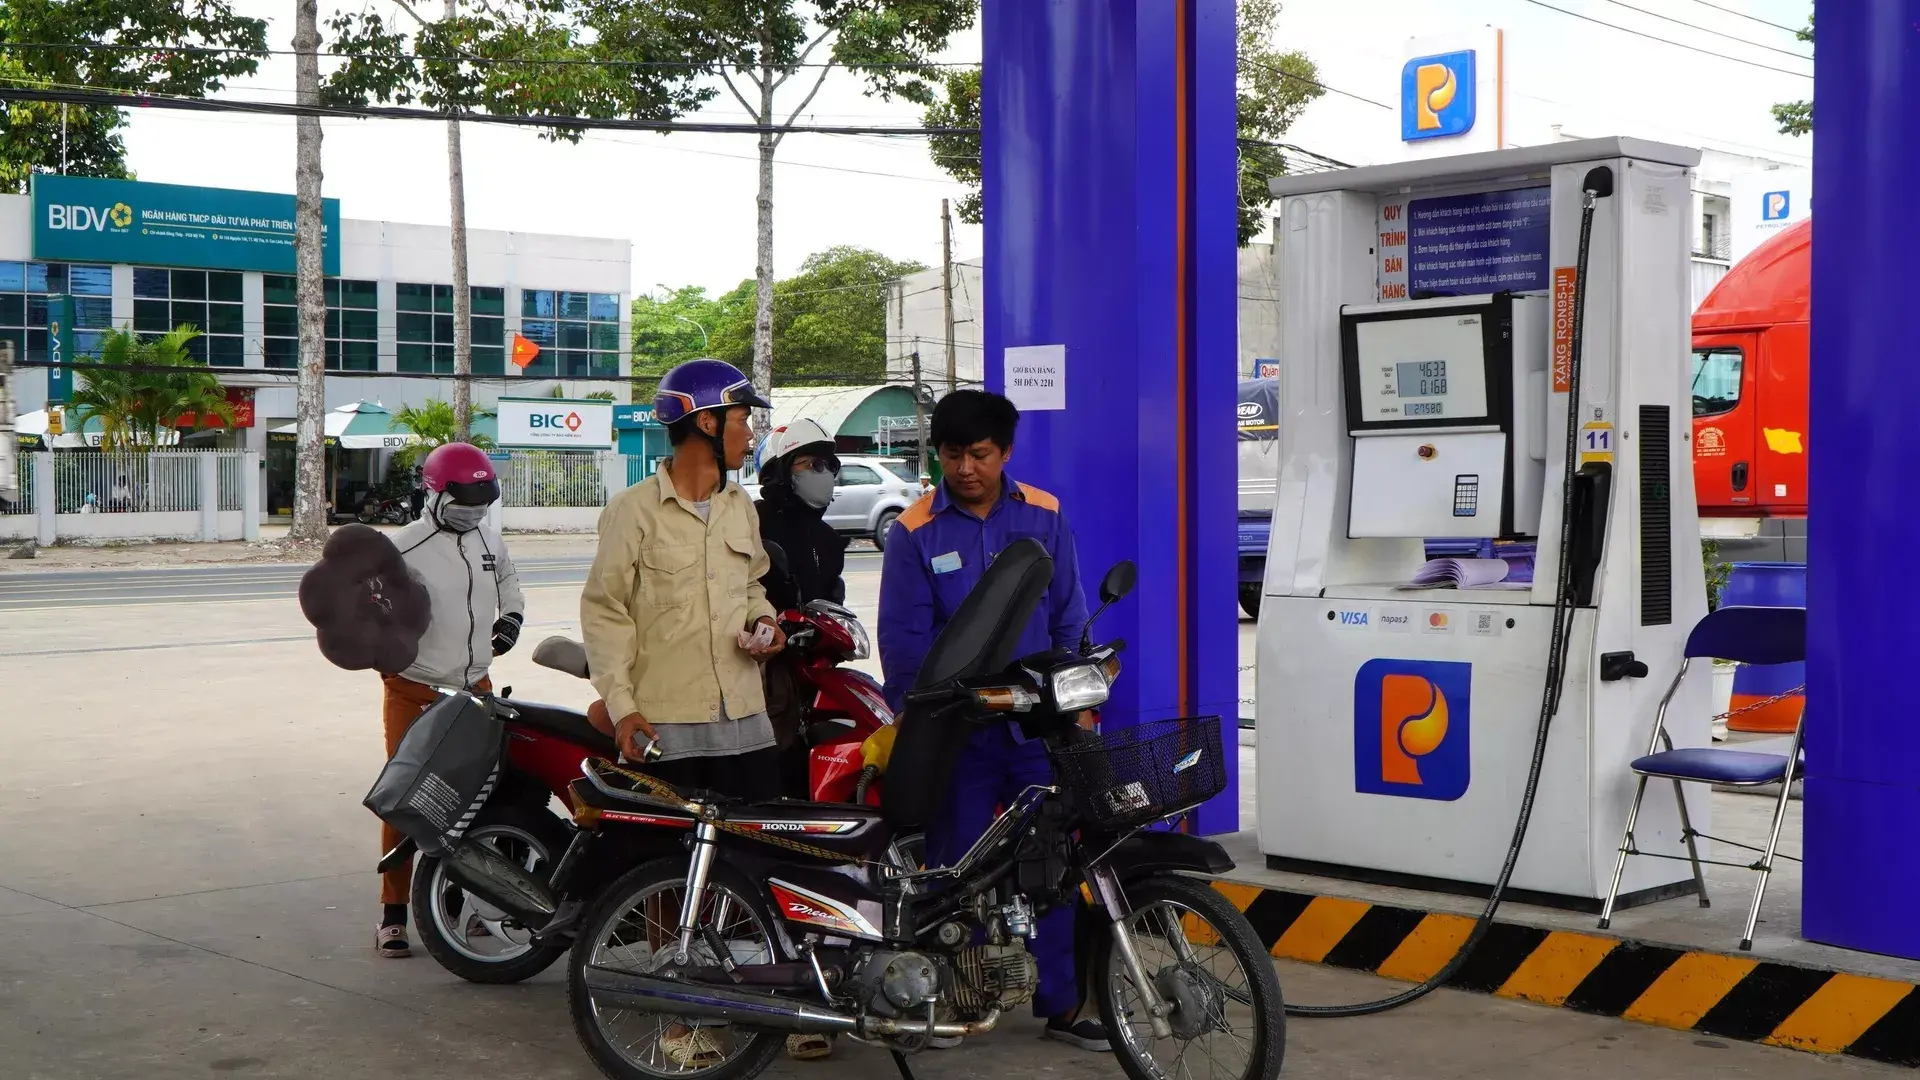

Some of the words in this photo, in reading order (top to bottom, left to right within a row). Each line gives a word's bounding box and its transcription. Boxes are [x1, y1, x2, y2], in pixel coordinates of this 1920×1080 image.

[49, 204, 110, 232] BIDV
[142, 208, 164, 220] NGÂN
[165, 210, 187, 222] HÀNG
[188, 213, 210, 223] TMCP
[211, 214, 227, 226] ĐẦU
[228, 216, 240, 226] TƯ
[240, 217, 250, 227] VÀ
[250, 218, 270, 228] PHÁT
[271, 219, 293, 230] TRIỂN
[1384, 205, 1402, 221] QUY
[1380, 229, 1406, 247] TRÌNH
[1385, 254, 1402, 273] BÁN
[1382, 281, 1406, 299] HÀNG
[1557, 275, 1568, 339] RON95-III
[53, 336, 61, 379] BDV
[1553, 344, 1567, 385] XĂNG
[1024, 365, 1036, 374] BÁN
[1037, 365, 1056, 374] HÀNG
[1420, 361, 1446, 377] 4633
[1013, 378, 1023, 387] 5H
[1040, 379, 1054, 387] 22H
[633, 411, 652, 422] BIDV
[1414, 403, 1441, 414] 27580
[530, 414, 564, 429] BIC
[383, 437, 409, 447] BIDV
[1586, 431, 1608, 449] 11
[1340, 611, 1368, 625] VISA
[817, 755, 848, 764] HONDA
[761, 823, 806, 831] HONDA
